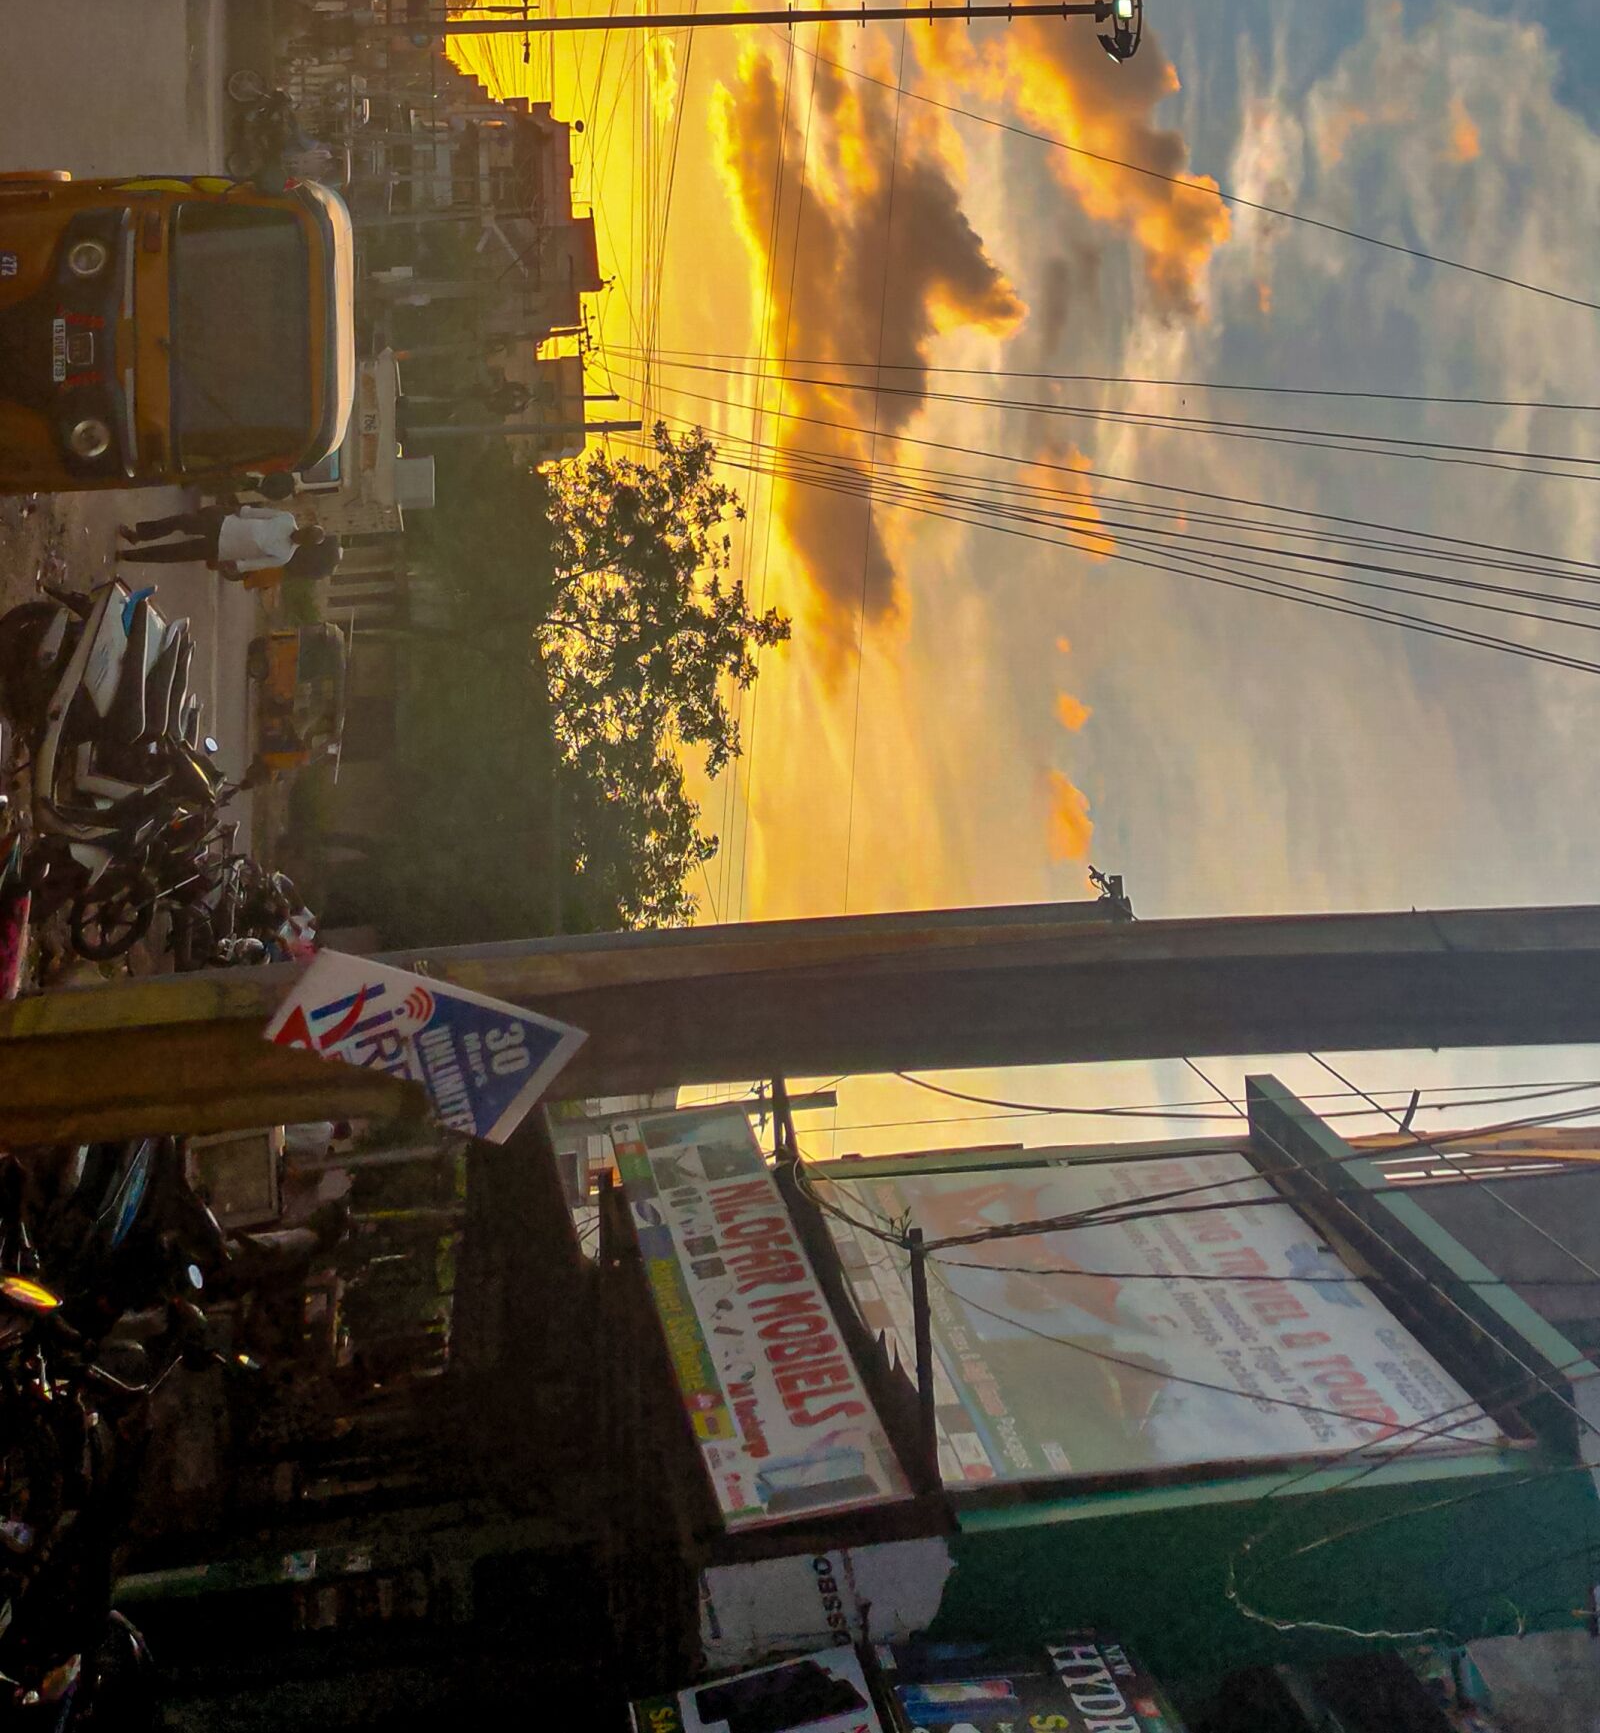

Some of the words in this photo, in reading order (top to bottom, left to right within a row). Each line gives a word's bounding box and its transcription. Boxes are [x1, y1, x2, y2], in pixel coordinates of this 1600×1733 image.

[484, 1022, 530, 1076] 30
[707, 1180, 807, 1295] NILOFAR
[747, 1290, 867, 1427] MOBIELS
[1100, 1644, 1137, 1677] NEW
